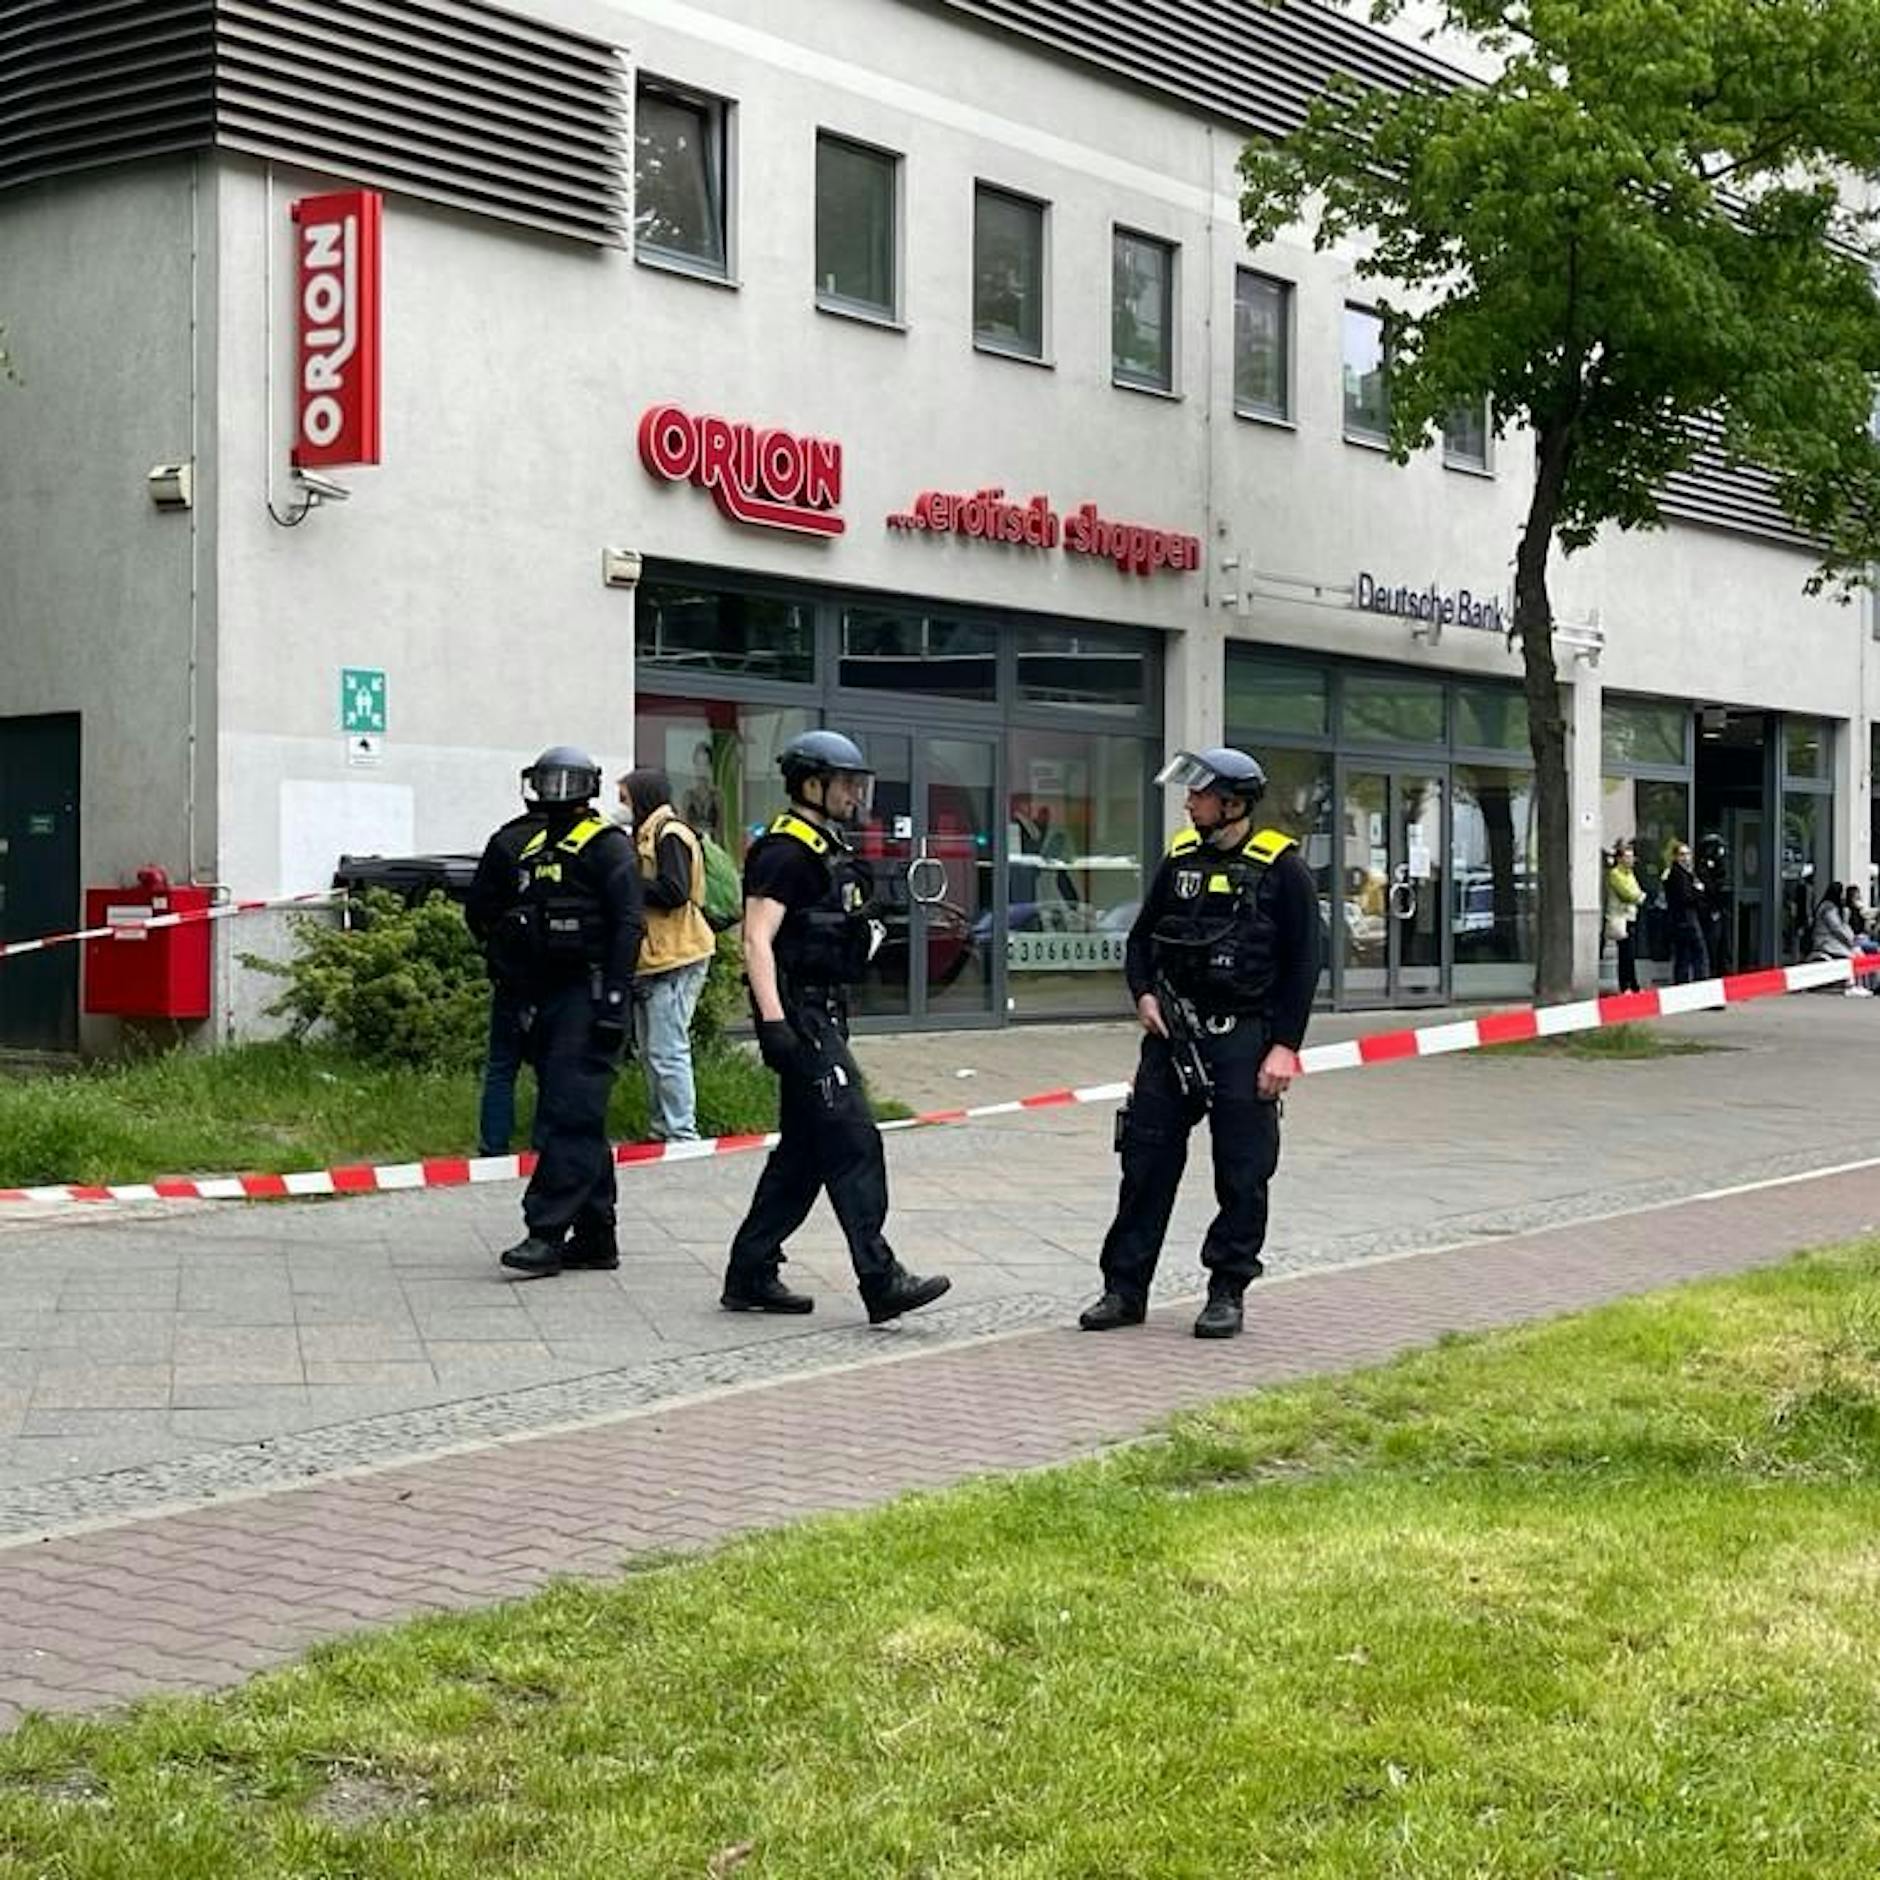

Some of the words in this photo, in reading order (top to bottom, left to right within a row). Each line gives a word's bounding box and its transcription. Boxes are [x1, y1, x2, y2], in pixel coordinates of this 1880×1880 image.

[303, 214, 358, 447] ORION
[638, 403, 847, 537] ORION
[1063, 503, 1201, 576] shoppen
[1358, 572, 1454, 624] Deutsche
[1458, 589, 1505, 632] Bank
